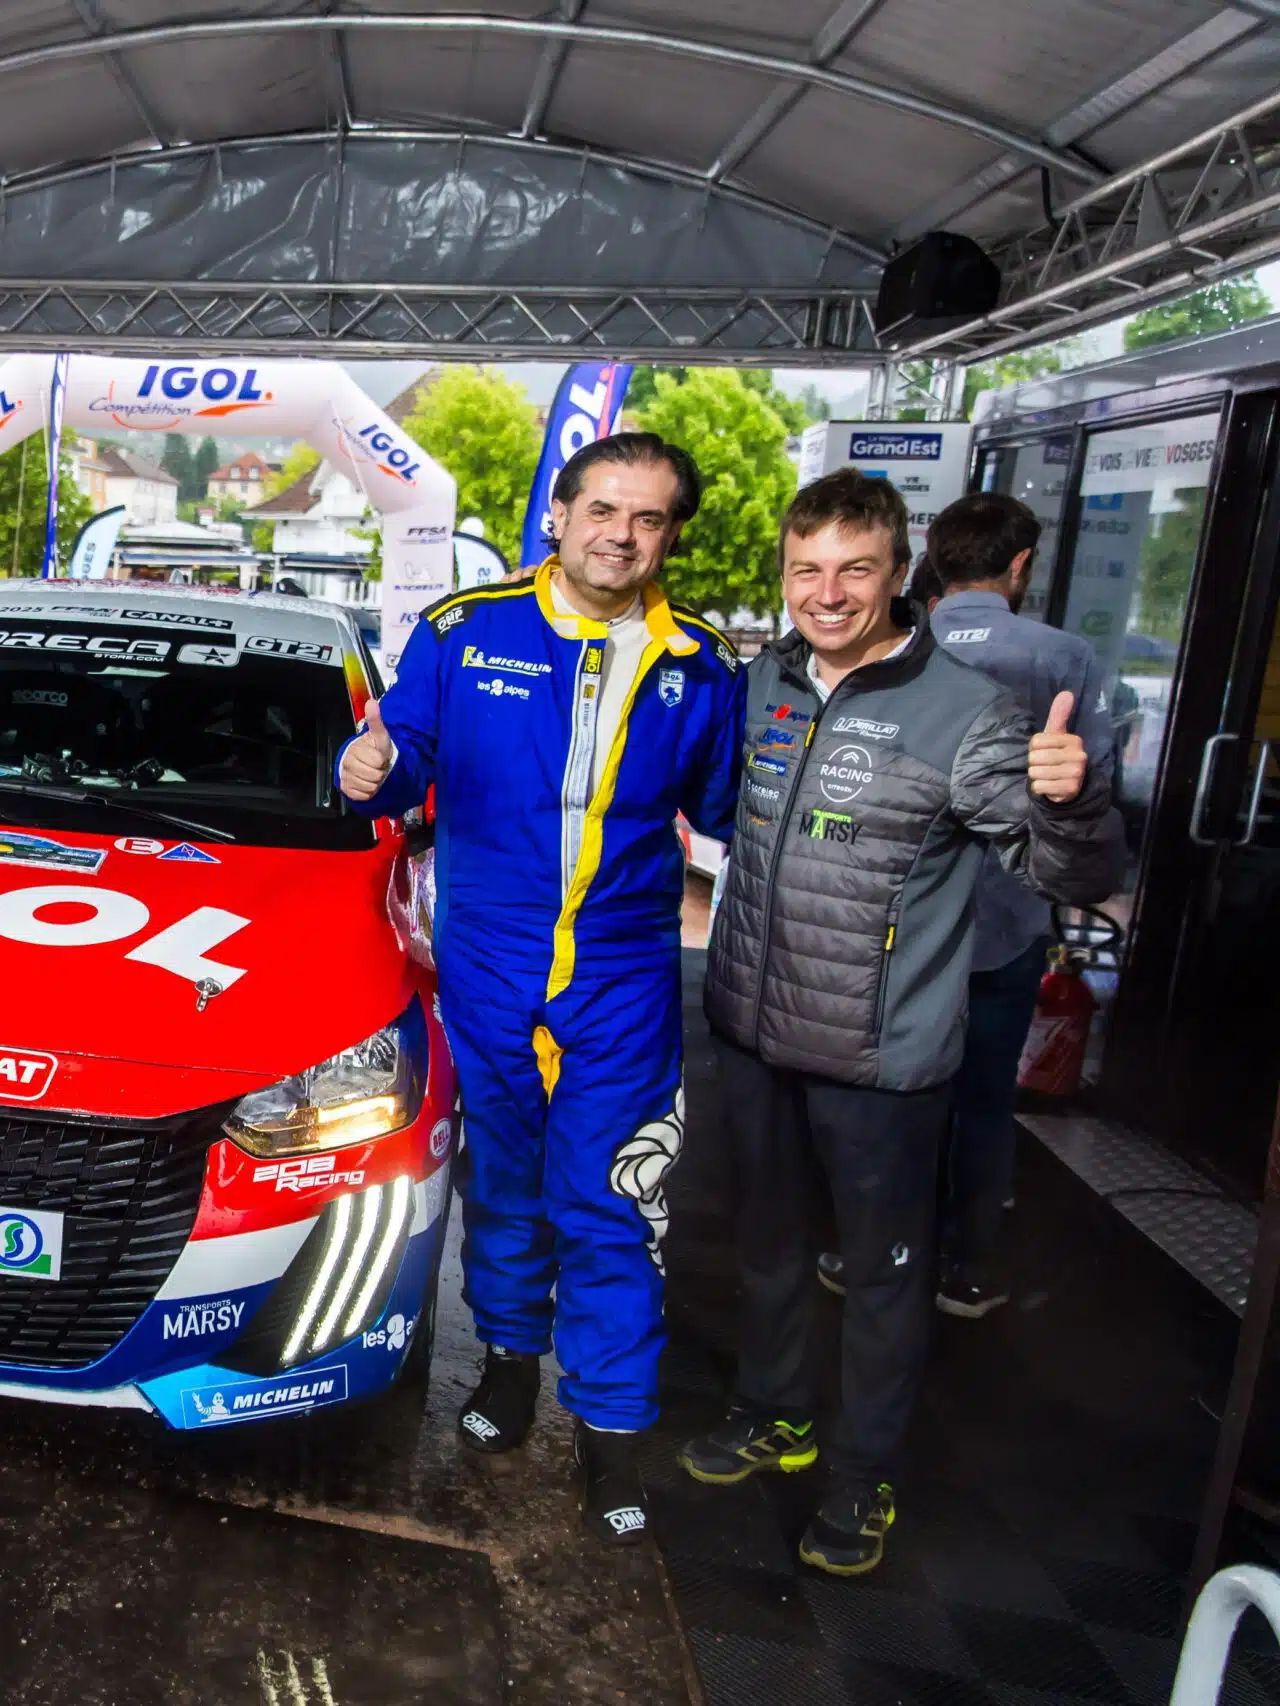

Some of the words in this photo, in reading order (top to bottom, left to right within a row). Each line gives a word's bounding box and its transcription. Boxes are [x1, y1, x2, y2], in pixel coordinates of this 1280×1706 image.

[137, 365, 263, 401] IGOL
[89, 396, 191, 418] Compétition
[359, 423, 420, 481] IGOL
[1135, 447, 1153, 469] VIE
[1165, 440, 1214, 465] VOSGES
[124, 610, 230, 630] CANAL+
[437, 608, 464, 631] OMP
[93, 652, 165, 663] STORE.COM
[487, 656, 553, 674] MICHELIN
[586, 648, 599, 672] OMP
[717, 644, 737, 668] OMP
[820, 763, 873, 784] RACING
[798, 811, 863, 846] MARSY
[433, 1125, 449, 1151] BELL
[253, 1156, 336, 1183] 208
[274, 1168, 366, 1193] Racing
[179, 1299, 231, 1313] TRANSPORTS
[163, 1302, 245, 1340] MARSY
[233, 1379, 335, 1410] MICHELIN
[463, 1413, 497, 1438] OMP
[609, 1510, 646, 1531] OMP
